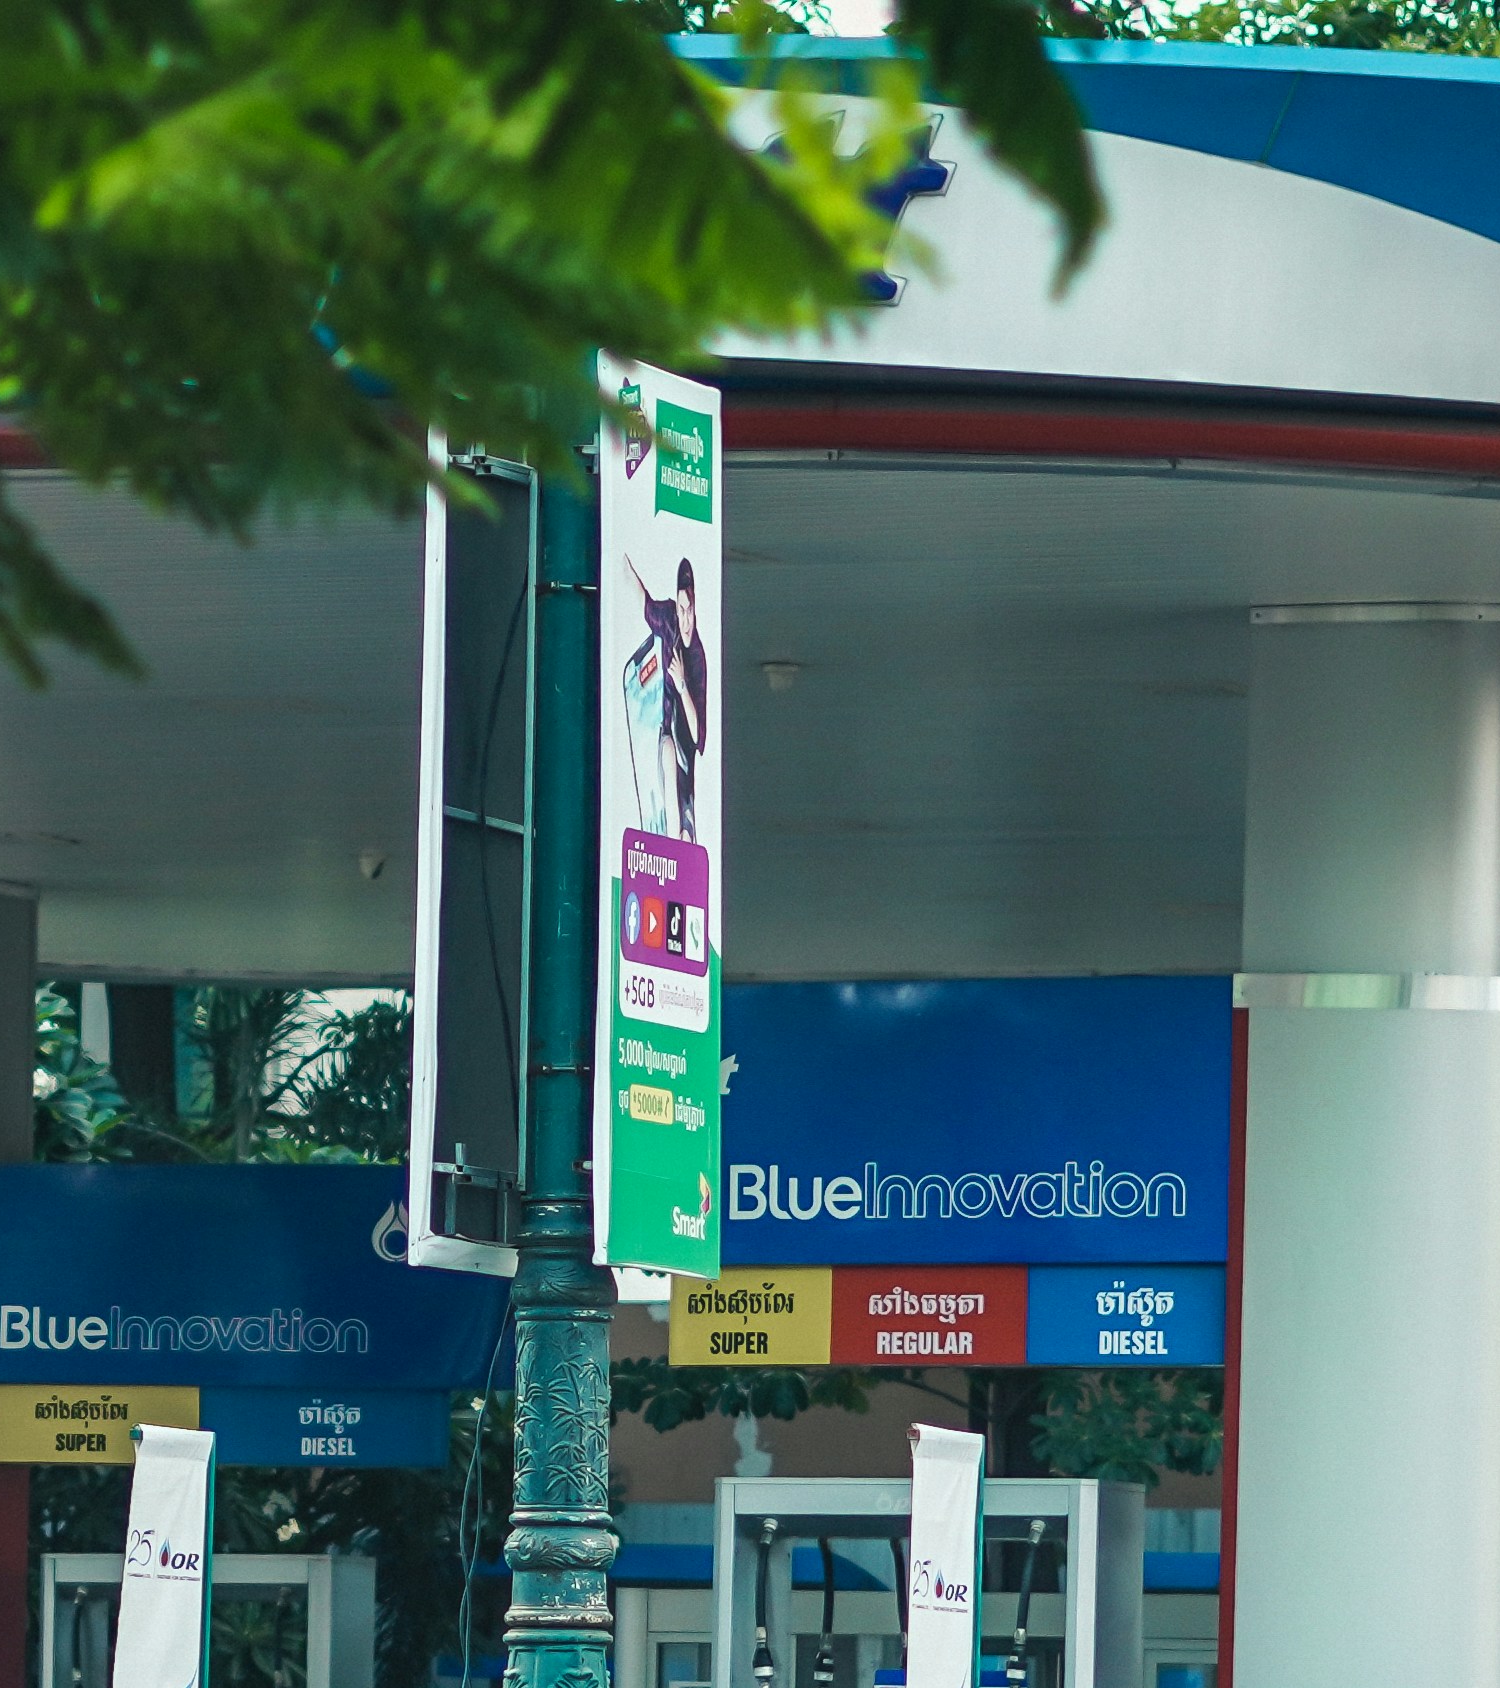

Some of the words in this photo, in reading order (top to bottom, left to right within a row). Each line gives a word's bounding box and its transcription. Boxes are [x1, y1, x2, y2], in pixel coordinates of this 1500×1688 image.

[728, 1160, 1186, 1220] BlueInnovation
[672, 1204, 706, 1240] Smart
[0, 1305, 368, 1353] BlueInnovation
[709, 1331, 769, 1355] SUPER
[876, 1331, 974, 1355] REGULAR
[1098, 1331, 1168, 1355] DIESEL
[55, 1433, 107, 1452] SUPER
[300, 1437, 356, 1456] DIESEL
[128, 1529, 155, 1566] 25
[171, 1553, 200, 1571] OR
[913, 1560, 932, 1598] 25
[945, 1584, 968, 1602] OR
